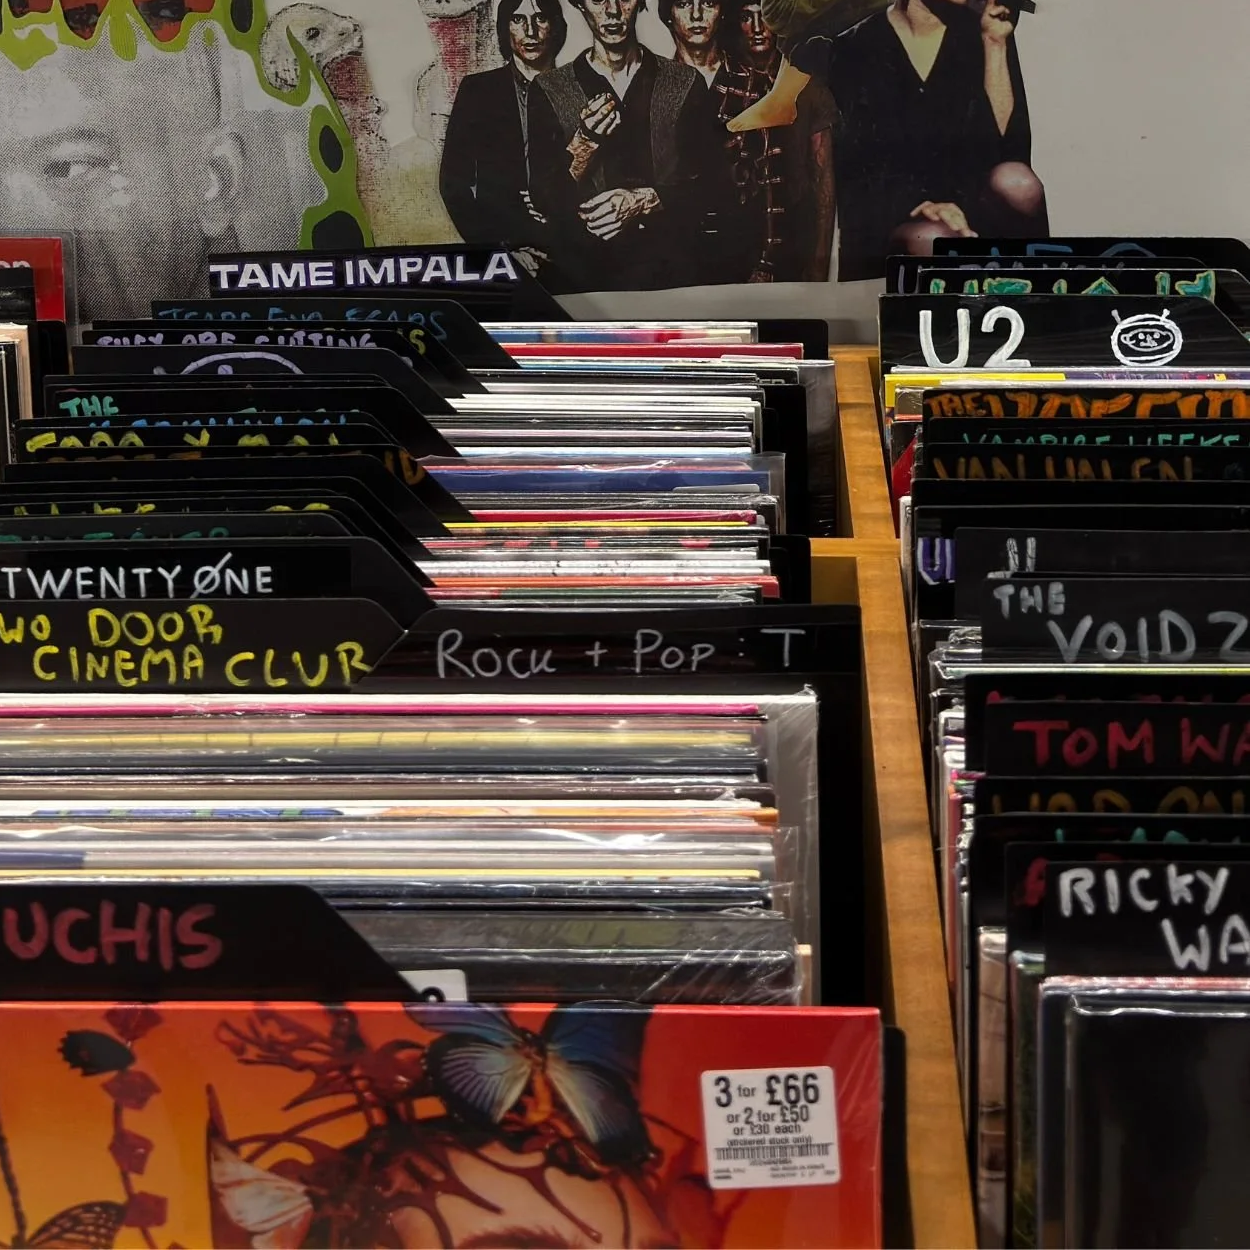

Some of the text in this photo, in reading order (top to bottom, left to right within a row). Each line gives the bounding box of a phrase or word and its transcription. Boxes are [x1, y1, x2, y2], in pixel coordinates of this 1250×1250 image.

[210, 251, 518, 290] TAME IMPALA
[918, 305, 1032, 369] U2
[0, 564, 183, 599] TWENTY
[993, 581, 1066, 620] THE
[87, 602, 225, 649] DOOR
[32, 643, 206, 688] CINEMA
[584, 639, 610, 668] +
[632, 628, 717, 675] Pop
[759, 628, 807, 668] T
[1012, 716, 1157, 770] TOM
[2, 900, 224, 972] UCHIS
[714, 1072, 820, 1108] 3 for £66
[726, 1104, 810, 1125] or 2 for £50
[733, 1126, 744, 1136] or
[774, 1124, 801, 1134] each
